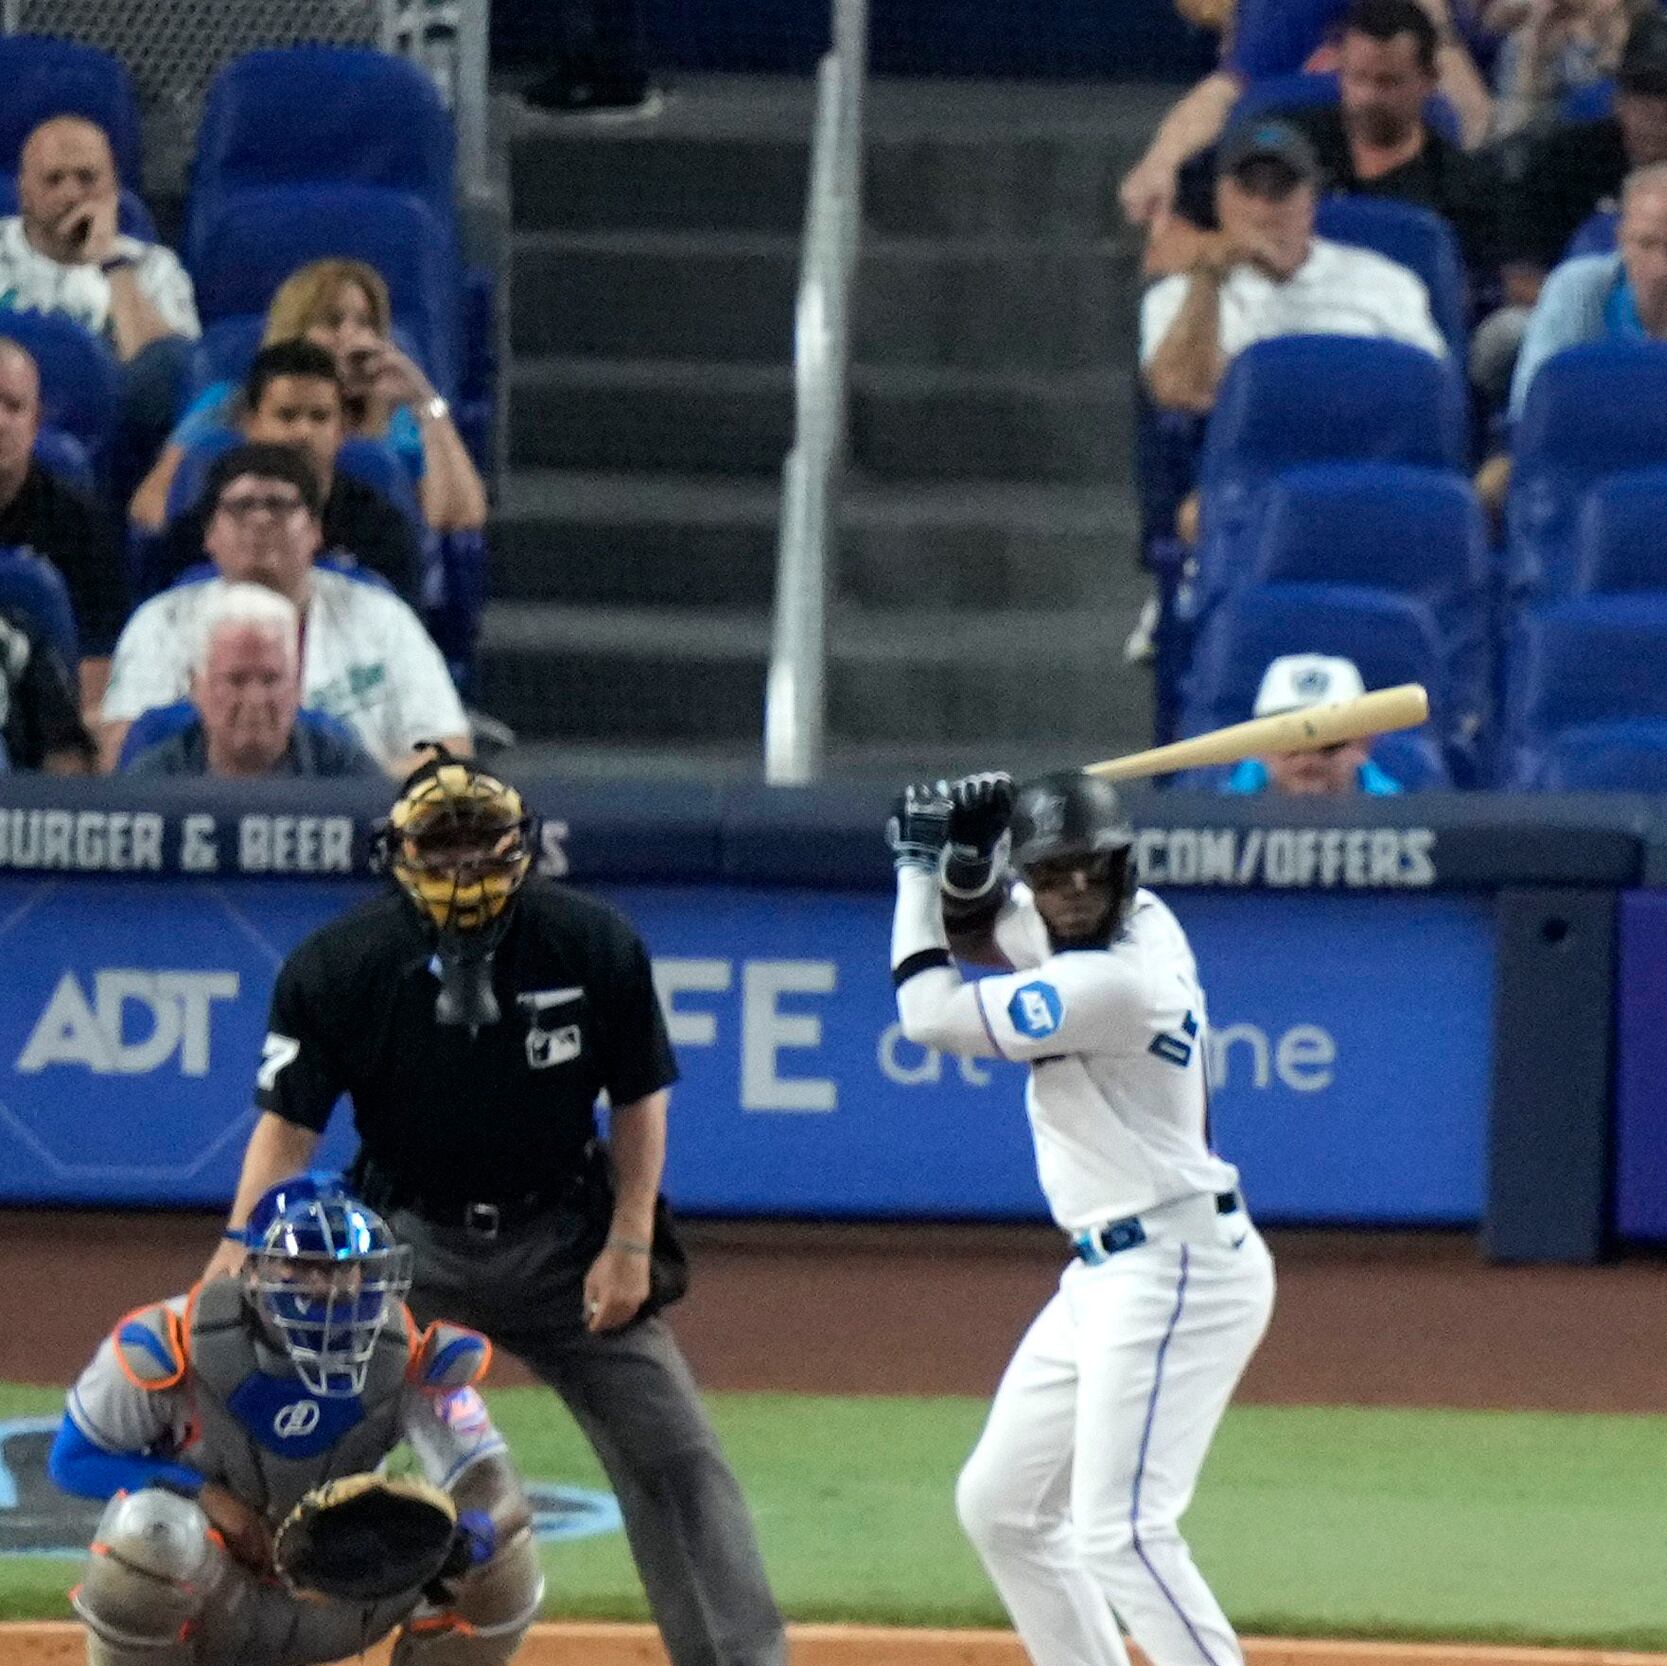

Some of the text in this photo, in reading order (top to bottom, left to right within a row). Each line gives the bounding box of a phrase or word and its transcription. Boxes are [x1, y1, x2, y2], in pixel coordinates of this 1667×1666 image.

[0, 808, 164, 873] URGER
[180, 812, 218, 873] &
[240, 814, 353, 874] BEER
[16, 968, 240, 1077] ADT
[651, 958, 838, 1113] FE
